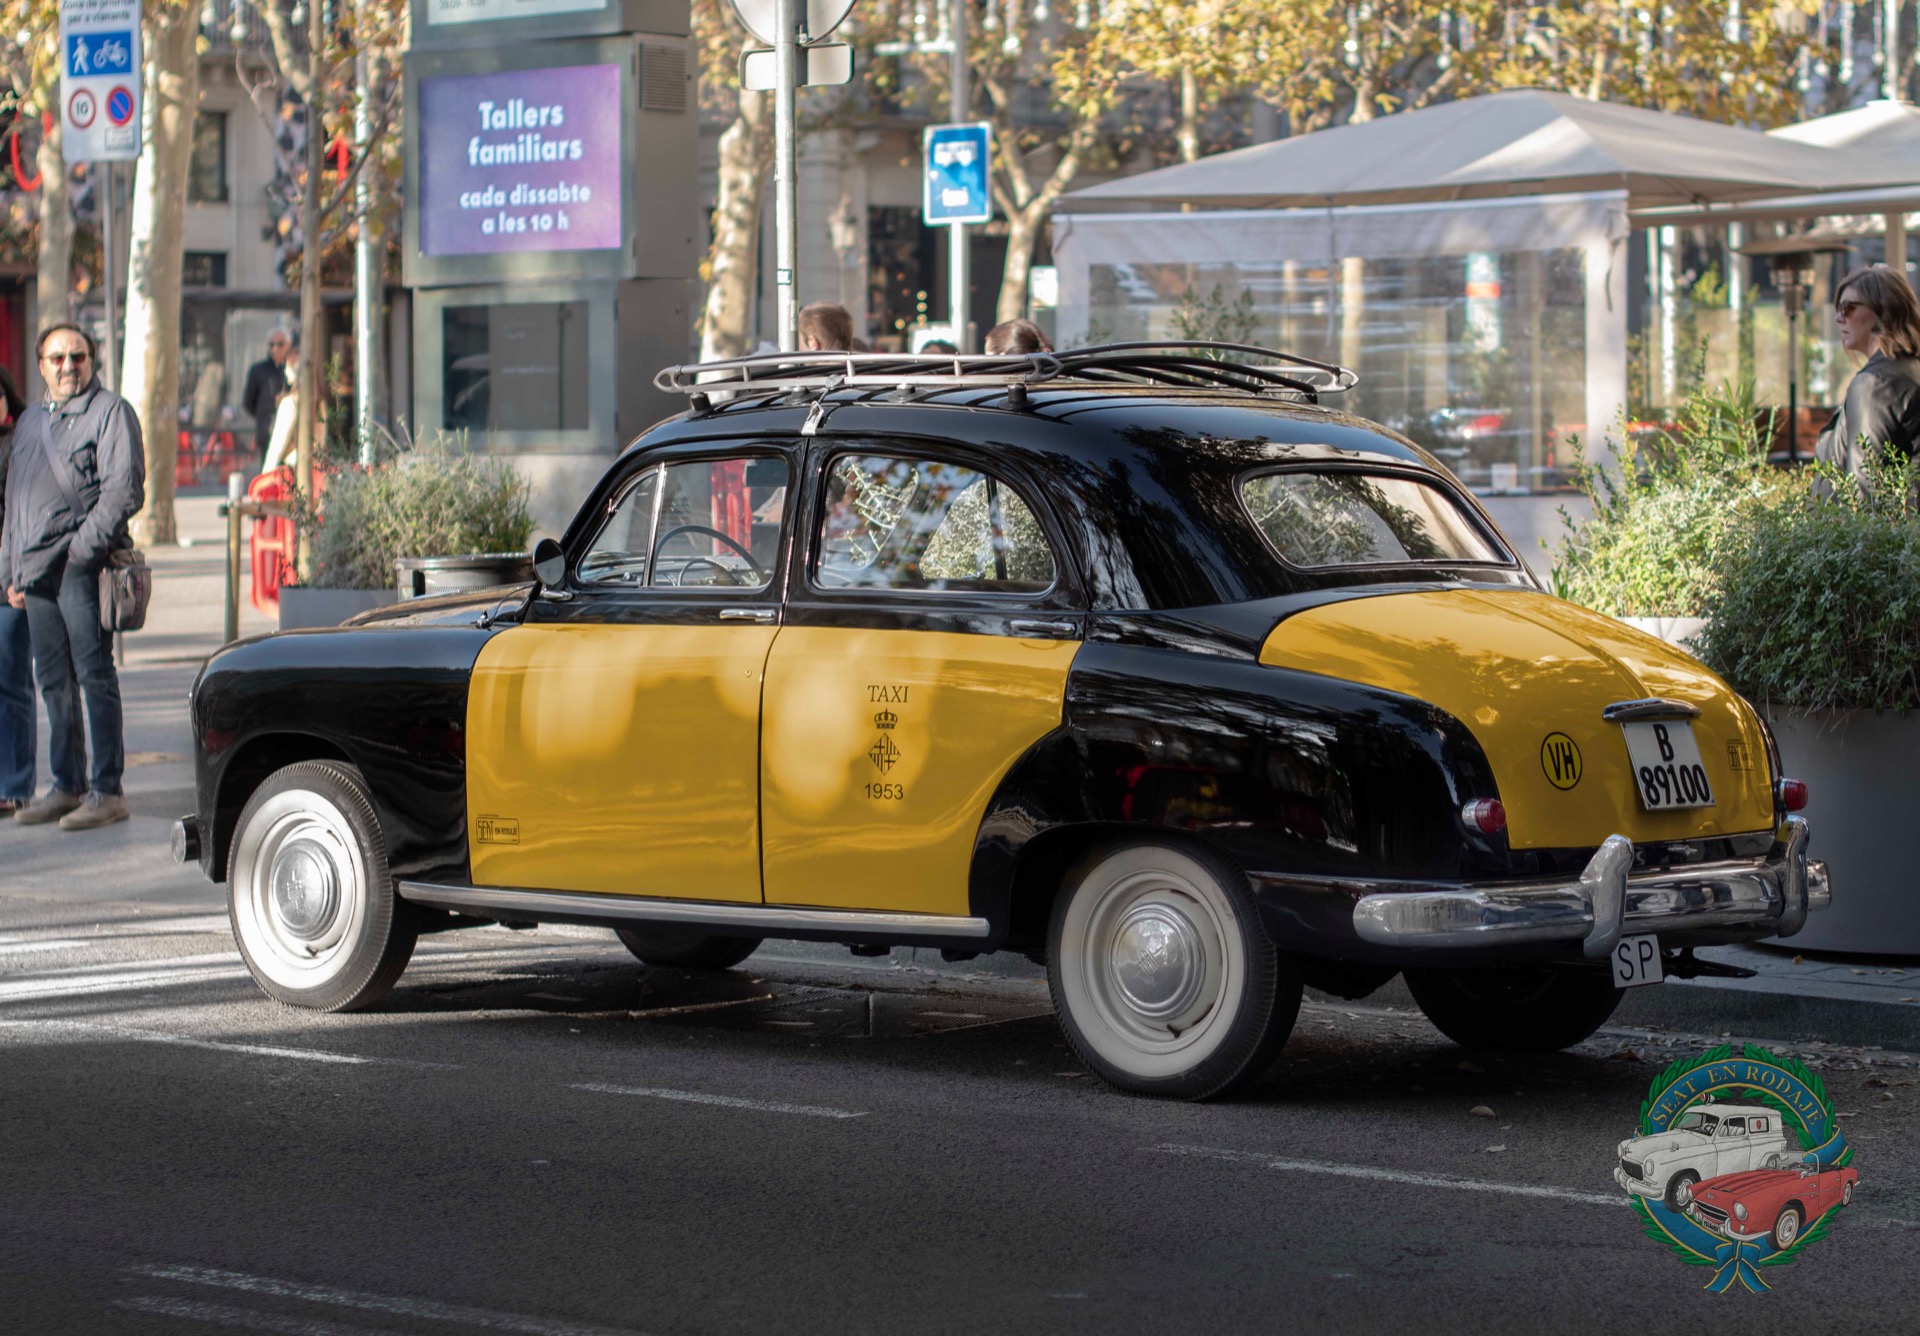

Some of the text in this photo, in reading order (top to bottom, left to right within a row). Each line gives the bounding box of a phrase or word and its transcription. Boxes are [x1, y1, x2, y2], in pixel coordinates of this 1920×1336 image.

[75, 101, 88, 115] 10
[478, 98, 565, 131] Tallers
[468, 133, 583, 166] familiars
[460, 181, 592, 209] cada dissabte
[482, 209, 569, 235] a les 10 h
[867, 685, 909, 703] TAXI
[1653, 724, 1675, 762] B
[1547, 741, 1576, 781] VH
[865, 783, 904, 800] 1953
[1639, 764, 1711, 806] 89100
[1617, 940, 1653, 982] SP
